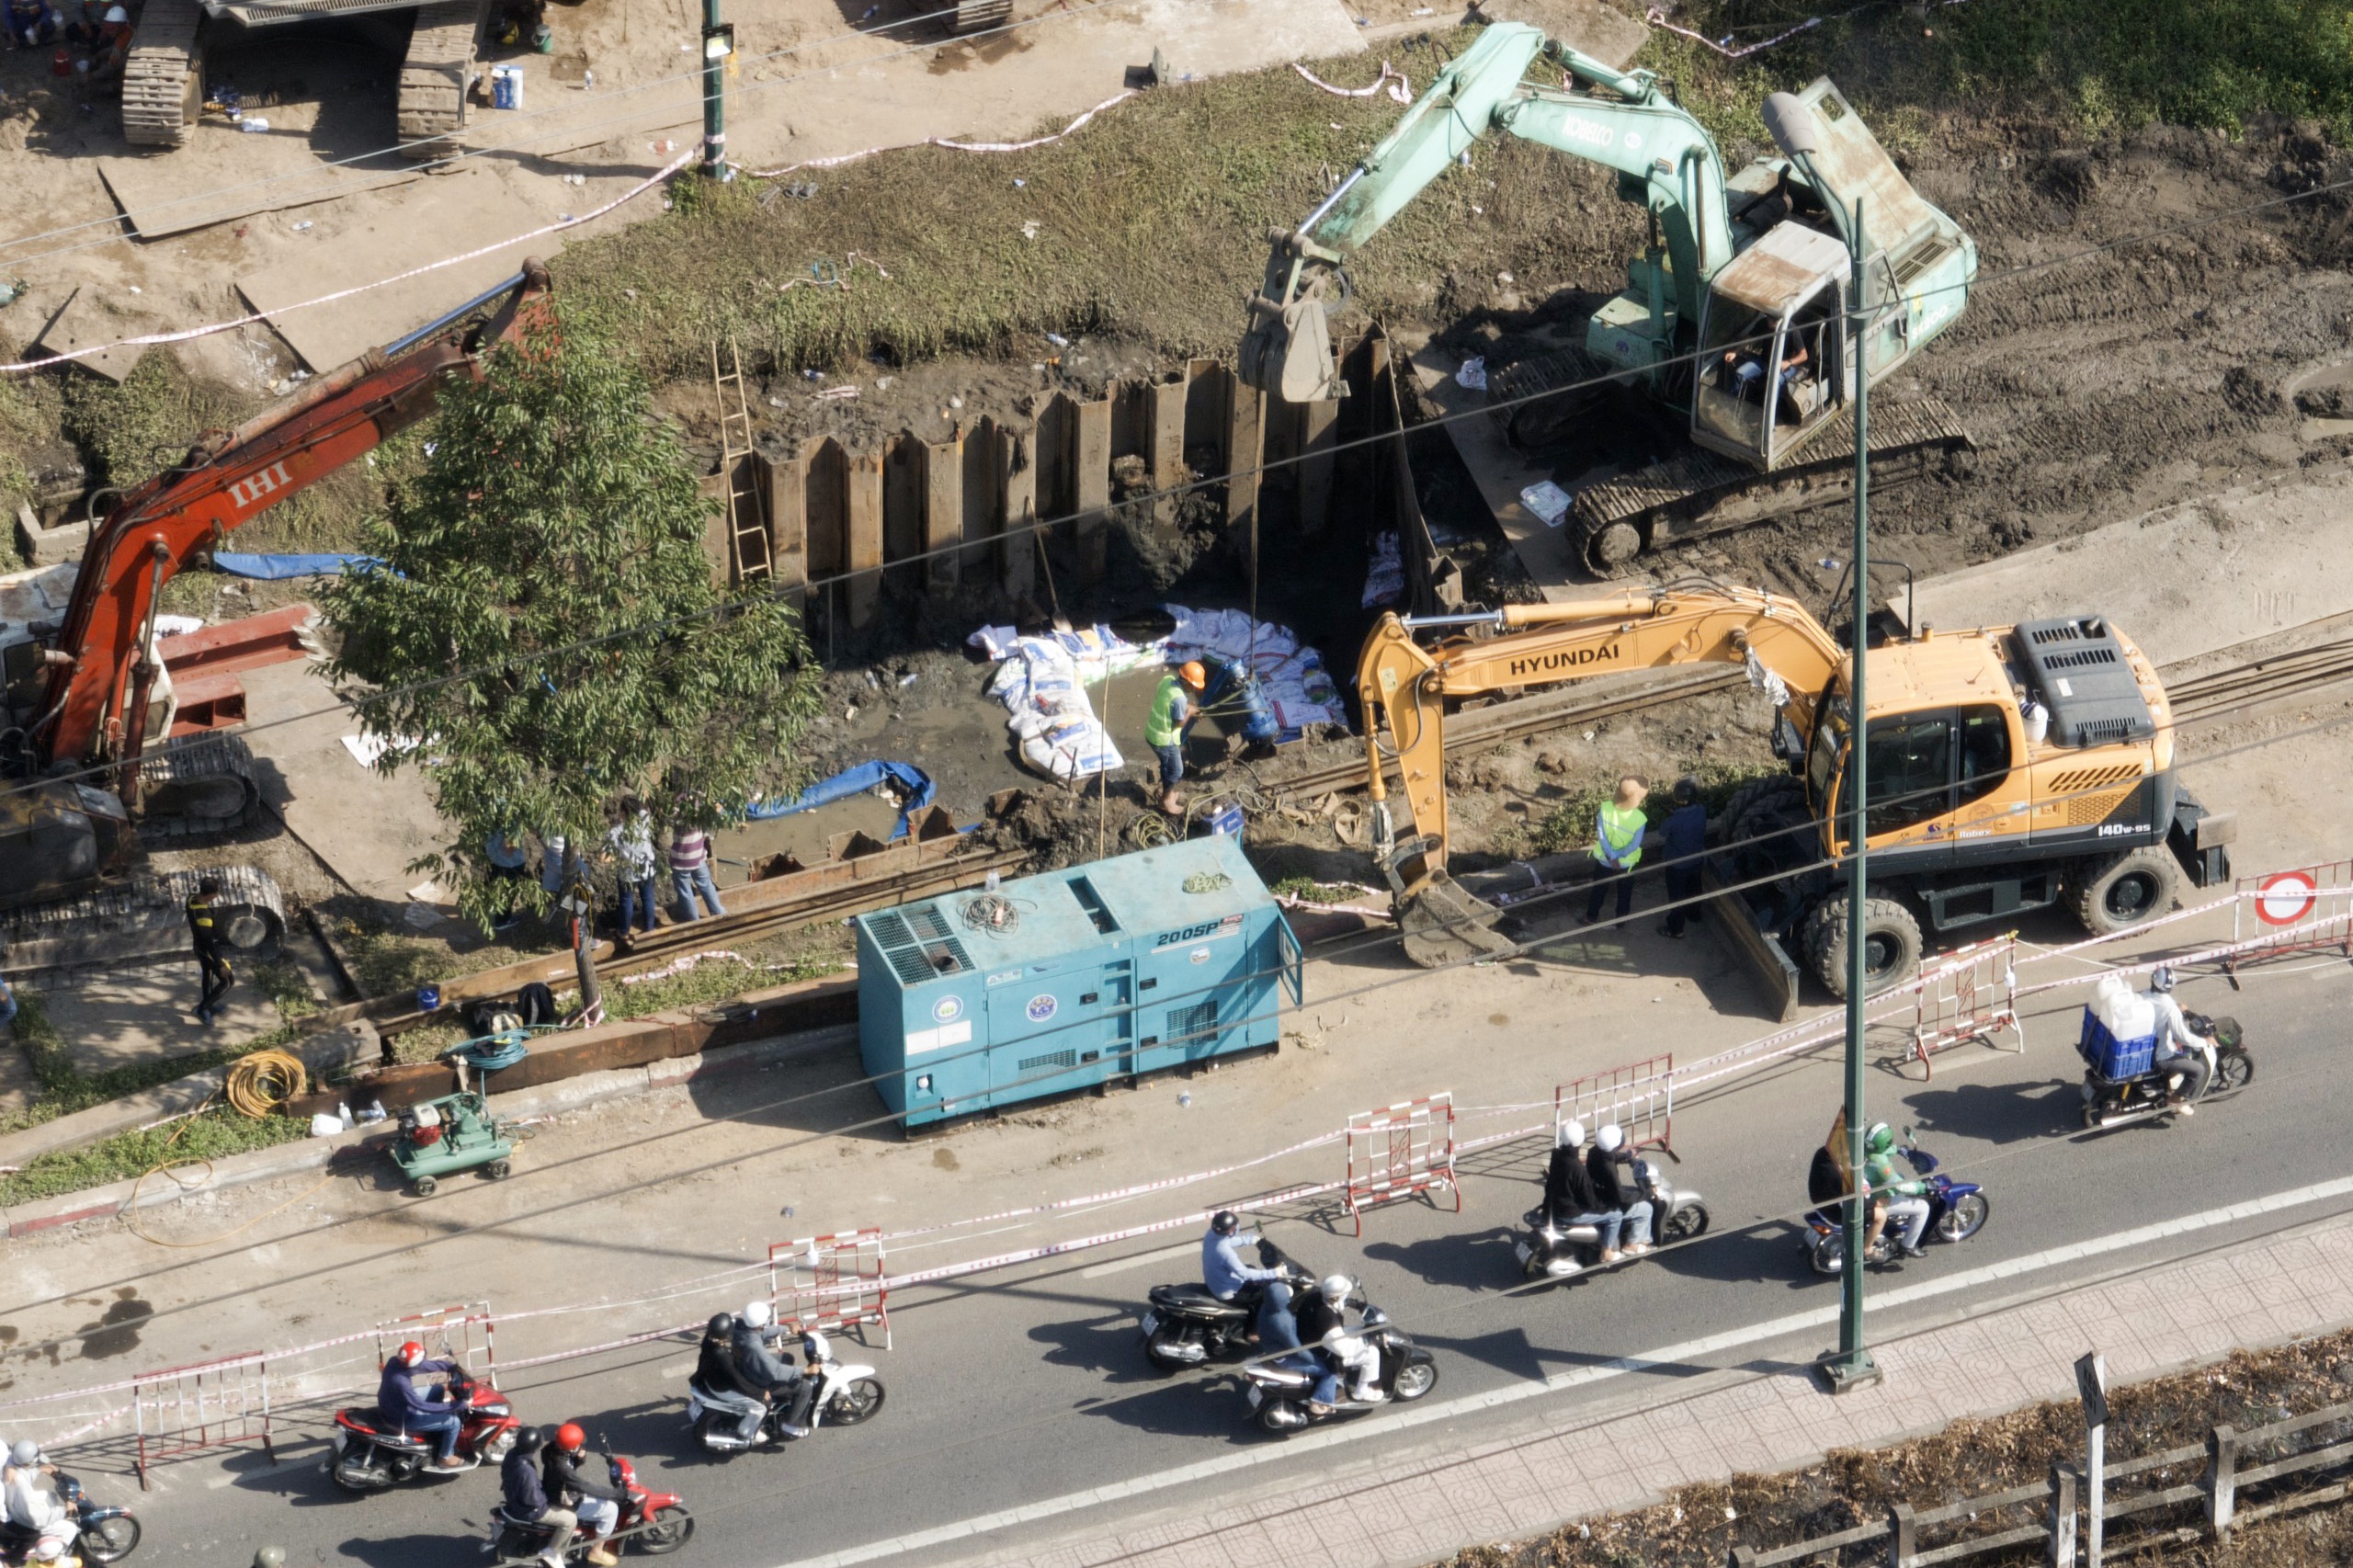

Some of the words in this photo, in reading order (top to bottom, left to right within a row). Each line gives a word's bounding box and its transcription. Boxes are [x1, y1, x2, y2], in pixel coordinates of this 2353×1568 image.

[1562, 115, 1614, 147] KOBELCO
[227, 460, 292, 508] IHI
[1510, 644, 1620, 676] HYUNDAI
[1156, 922, 1220, 947] 200SP
